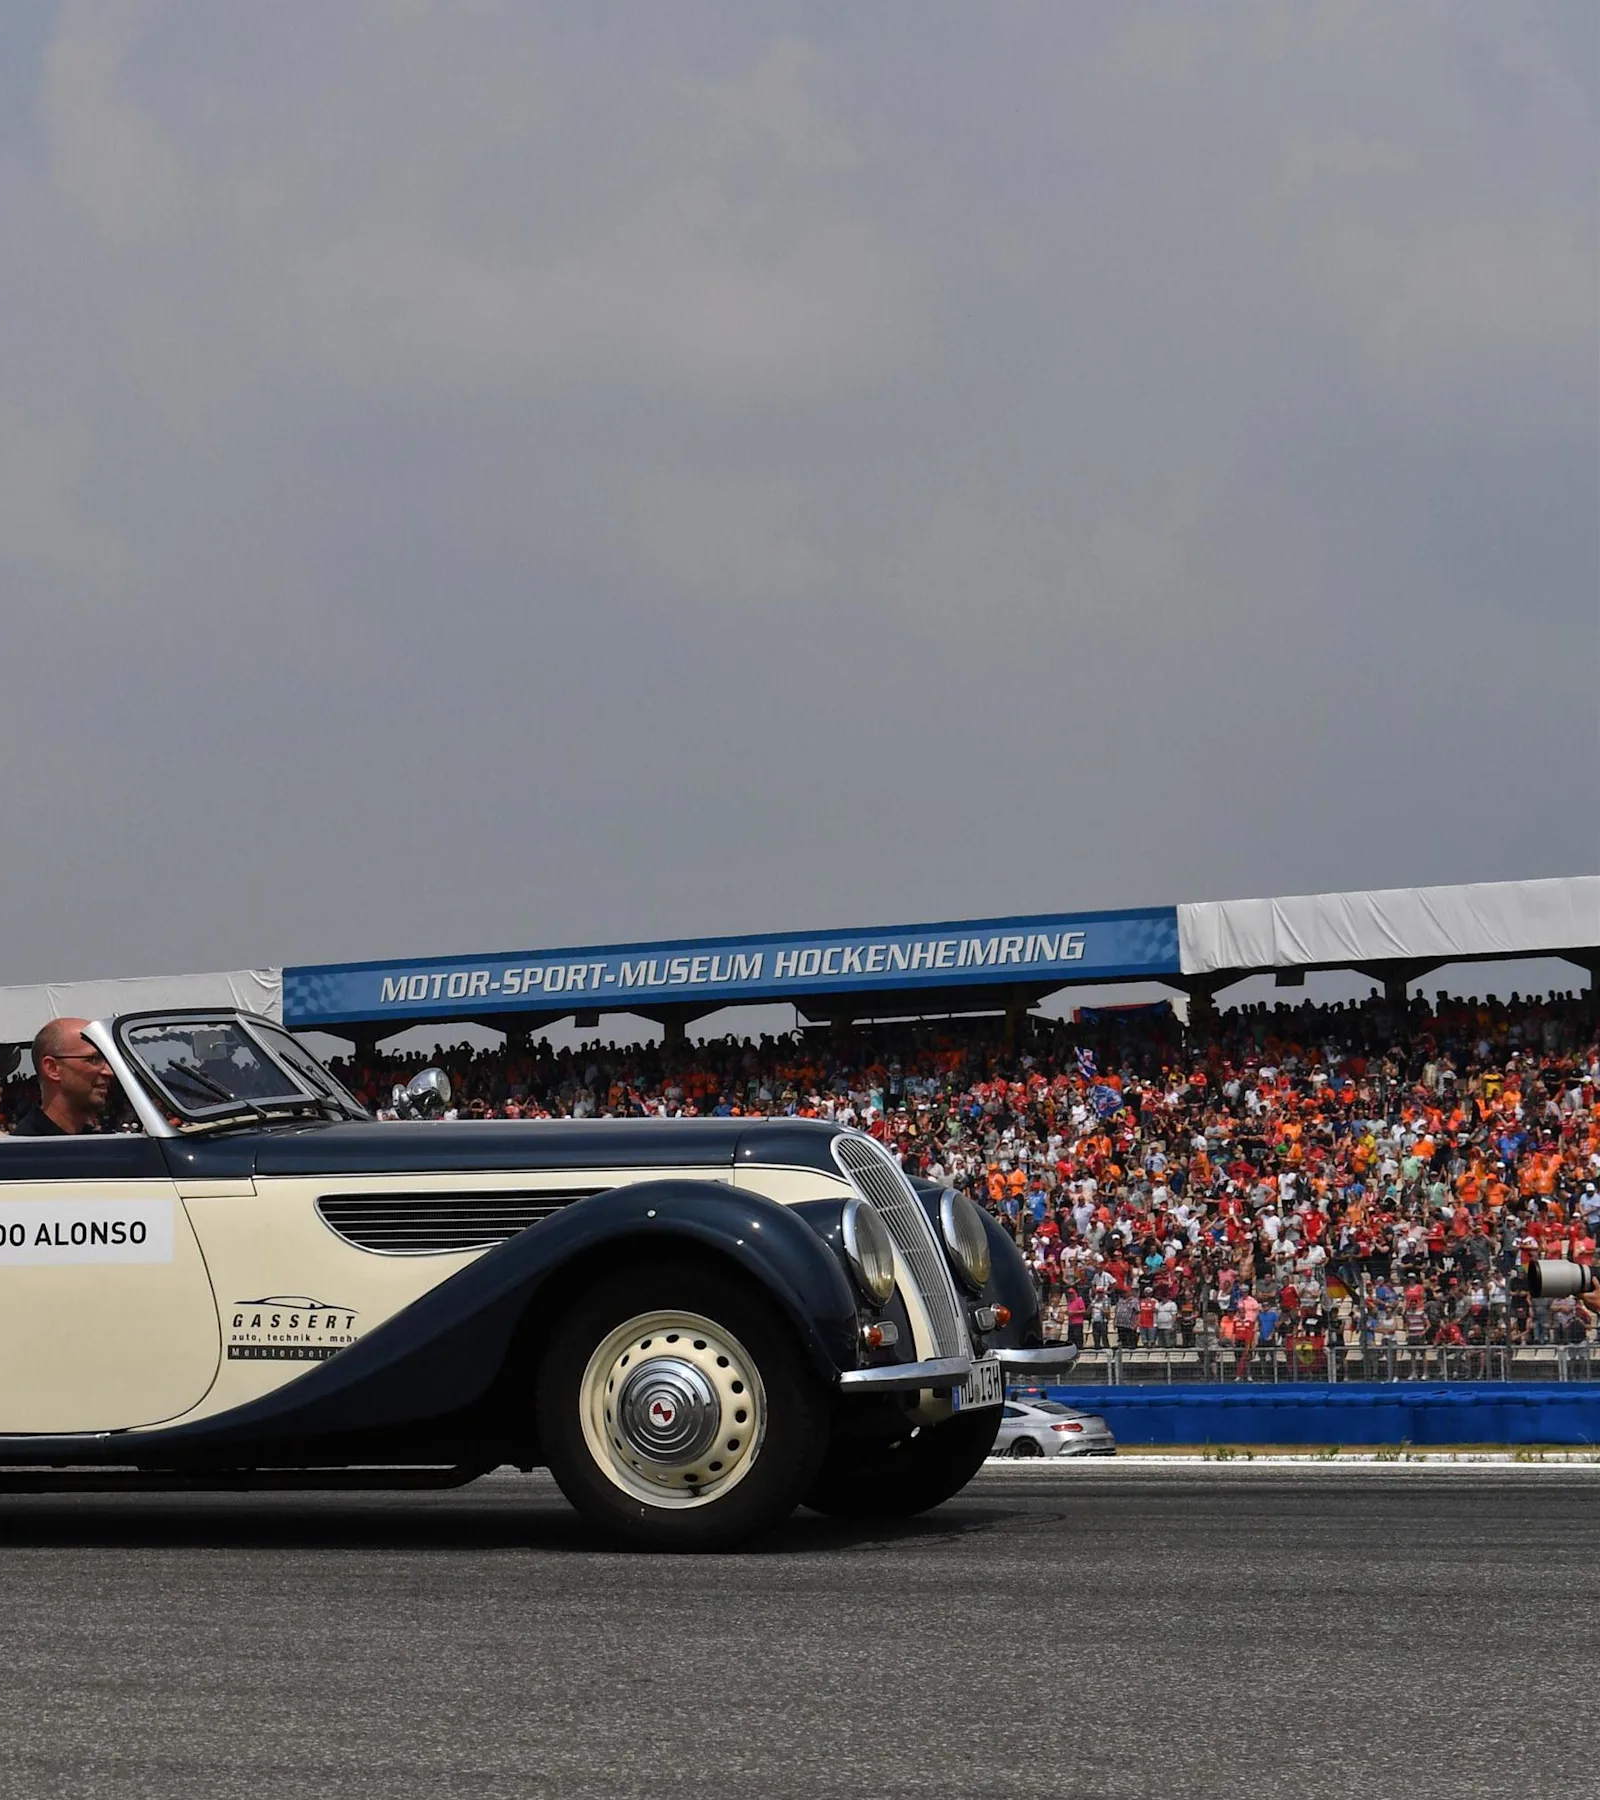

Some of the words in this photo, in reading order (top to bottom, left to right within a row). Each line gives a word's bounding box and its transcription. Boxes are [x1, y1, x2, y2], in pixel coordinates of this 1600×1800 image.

[380, 953, 763, 1003] MOTOR-SPORT-MUSEUM
[774, 931, 1087, 979] HOCKENHEIMRING
[34, 1221, 147, 1246] ALONSO
[233, 1313, 355, 1329] GASSERT
[232, 1334, 261, 1343] auto,
[268, 1334, 311, 1342] technik
